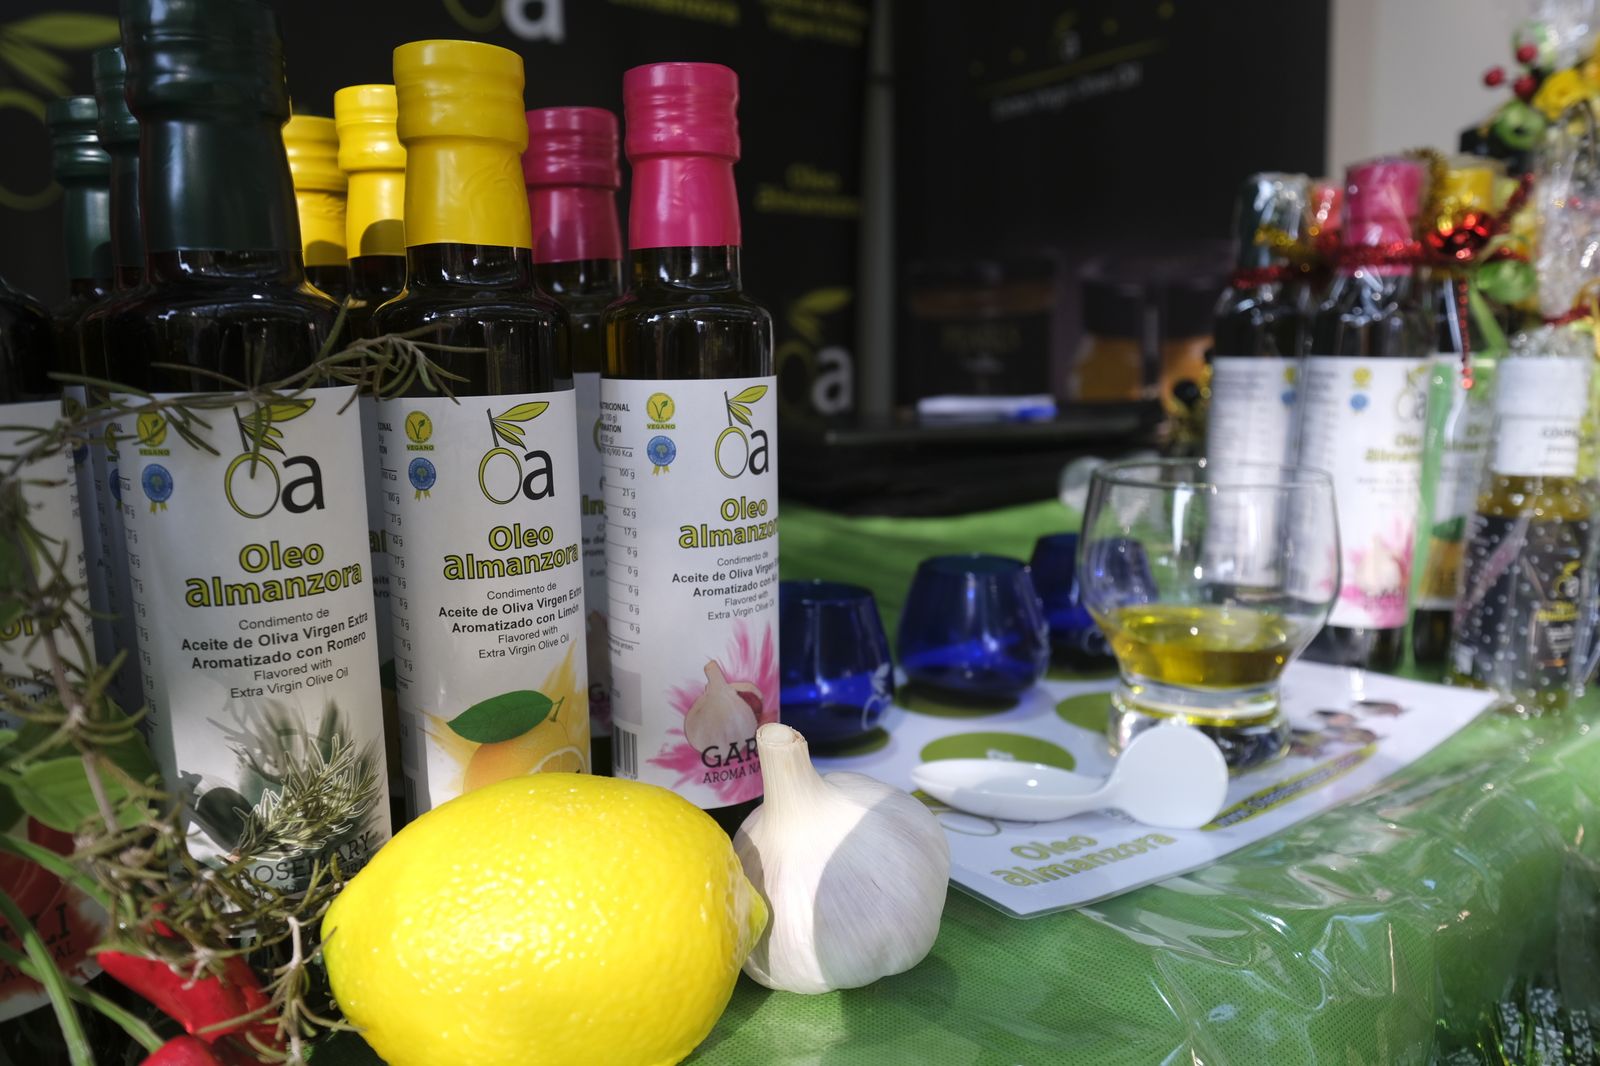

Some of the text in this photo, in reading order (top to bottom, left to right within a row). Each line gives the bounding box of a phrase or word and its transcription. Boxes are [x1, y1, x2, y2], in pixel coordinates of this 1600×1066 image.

[714, 426, 769, 479] Oa
[224, 451, 325, 519] Oa
[478, 447, 555, 505] Oa
[720, 496, 768, 522] Oleo
[489, 523, 554, 551] Oleo
[239, 540, 324, 573] Oleo
[443, 543, 579, 580] almanzora
[717, 553, 761, 567] Condimento
[185, 563, 362, 608] almanzora
[671, 573, 709, 583] Aceite
[712, 571, 726, 581] de
[729, 568, 753, 580] Oliva
[487, 582, 557, 601] Condimento de
[693, 581, 758, 598] Aromatizado
[724, 594, 757, 607] Flavored
[438, 607, 478, 618] Aceite
[482, 605, 498, 616] de
[502, 601, 534, 615] Oliva
[537, 593, 568, 609] Virgen
[452, 603, 580, 634] Aromatizado con Limón
[707, 611, 731, 621] Extra
[732, 607, 754, 618] Virgin
[182, 611, 368, 652] Aceite de Oliva Virgen Extra
[238, 608, 330, 631] Condimento de
[479, 633, 570, 659] Extra Virgin Olive Oil
[498, 625, 558, 644] Flavored with
[192, 631, 367, 669] Aromatizado con Romero
[254, 657, 332, 681] Flavored with
[230, 667, 349, 699] Extra Virgin Olive Oil
[703, 766, 747, 784] AROMA
[244, 830, 371, 884] OSEMARY
[990, 833, 1178, 887] almanzora
[1010, 835, 1098, 861] Oleo
